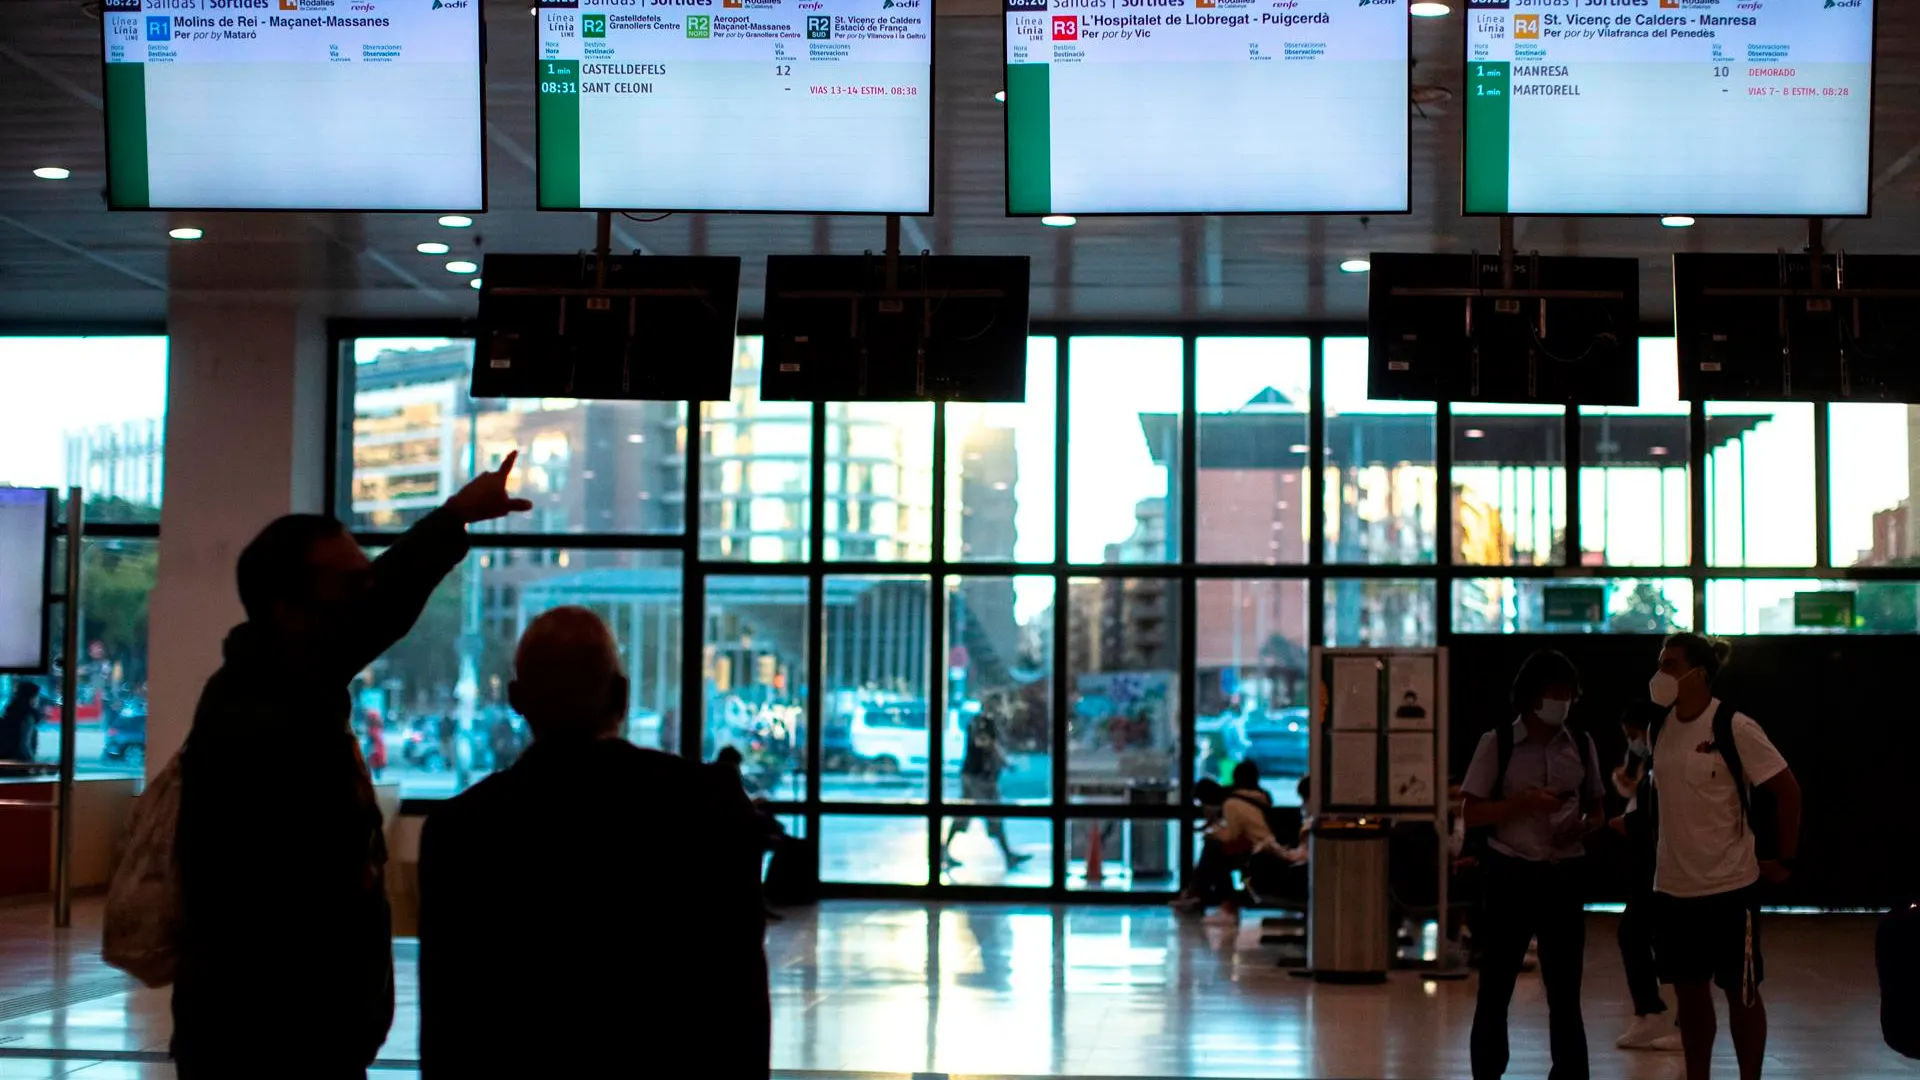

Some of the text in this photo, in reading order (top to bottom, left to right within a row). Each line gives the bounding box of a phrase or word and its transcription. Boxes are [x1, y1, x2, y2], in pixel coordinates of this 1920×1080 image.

[210, 0, 268, 8] Sortides
[351, 2, 375, 12] renfe
[798, 1, 823, 11] renfe
[1273, 0, 1298, 9] renfe
[1737, 1, 1762, 11] renfe
[174, 16, 390, 30] Molins de Rei Maçanet-Massanes
[548, 14, 574, 22] Línea
[688, 17, 708, 29] R2
[848, 16, 874, 25] Vicenç
[1015, 17, 1043, 26] Línea
[1082, 13, 1330, 28] L'Hospitalet de Llobregat Puigcerdà
[1544, 14, 1756, 28] St. Vicenç de Calders Manresa
[150, 22, 168, 35] R1
[550, 23, 574, 31] Línia
[584, 20, 604, 33] R2
[714, 23, 790, 31] Maçanet-Massanes
[808, 18, 829, 31] R2
[835, 24, 865, 32] Estació
[880, 24, 908, 33] França
[1054, 21, 1075, 35] R3
[1516, 20, 1537, 33] R4
[1018, 26, 1043, 35] Línia
[1082, 29, 1150, 40] Per por by Vic
[1564, 31, 1581, 39] por
[1583, 30, 1596, 39] by
[1598, 29, 1649, 38] Vilafranca
[1652, 29, 1667, 38] del
[1671, 29, 1715, 38] Penedès
[174, 30, 256, 42] Per por by Mataró
[548, 64, 555, 74] 1
[583, 64, 666, 74] CASTELLDEFELS
[776, 66, 791, 76] 12
[1477, 66, 1484, 76] 1
[1513, 66, 1569, 76] MANRESA
[1714, 66, 1729, 77] 10
[1749, 68, 1796, 77] DEMORADO
[541, 82, 576, 93] 08:31
[582, 83, 652, 93] SANT CELONI
[810, 86, 917, 95] VIAS 13-14 ESTIM. 08:38
[1477, 85, 1484, 95] 1
[1513, 85, 1580, 95] MARTORELL
[1749, 88, 1766, 96] VIAS
[1792, 88, 1819, 96] ESTIM.
[1823, 88, 1849, 96] 08:28
